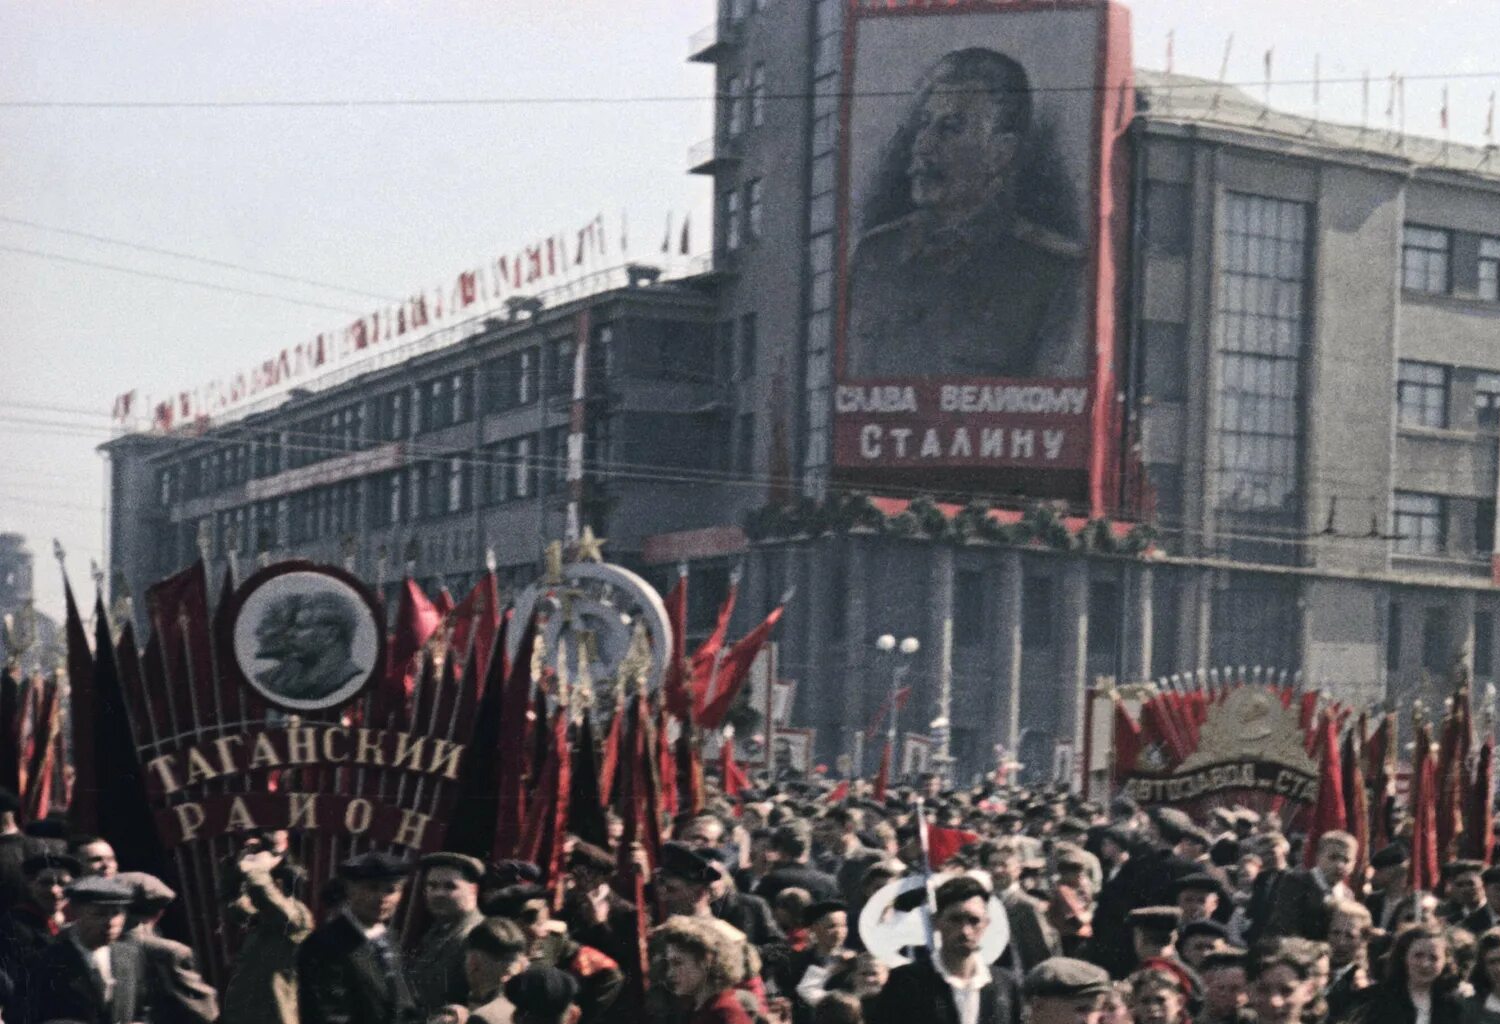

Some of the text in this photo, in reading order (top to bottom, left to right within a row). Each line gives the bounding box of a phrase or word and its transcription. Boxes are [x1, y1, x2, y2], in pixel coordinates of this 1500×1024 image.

[836, 385, 1087, 414] СЛАВА ВЕЛИКОМУ
[860, 424, 1064, 459] СТАЛИНУ
[173, 792, 431, 849] РАЙОН
